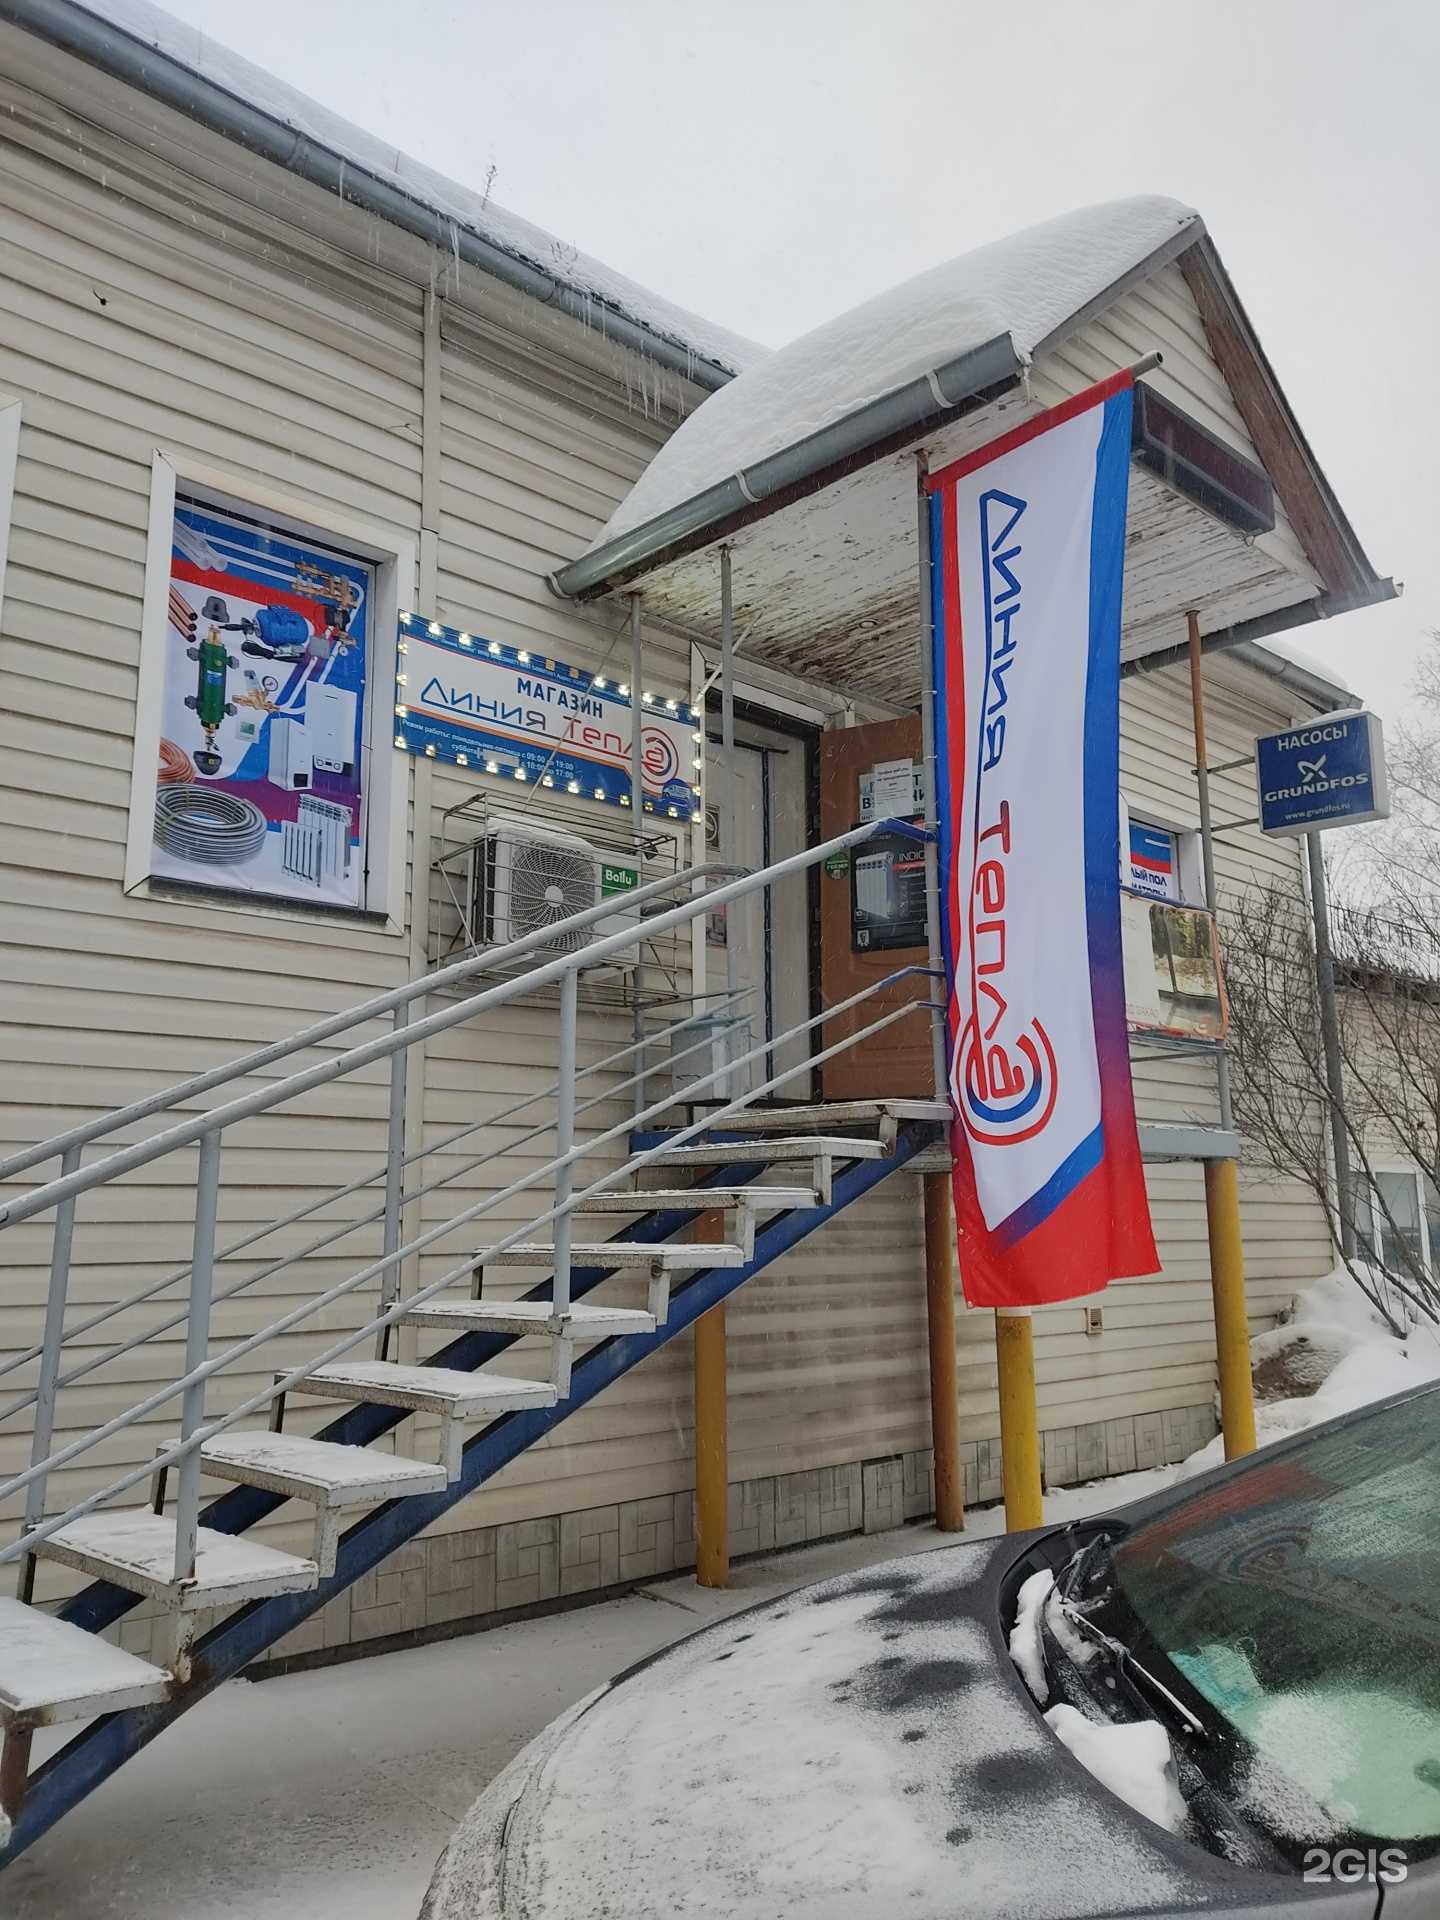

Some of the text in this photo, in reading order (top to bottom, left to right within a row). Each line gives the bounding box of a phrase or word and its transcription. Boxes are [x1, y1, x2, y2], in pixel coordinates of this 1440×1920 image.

[517, 677, 603, 719] МАГАЗИН
[1278, 724, 1348, 752] НАСОСЫ
[1264, 773, 1369, 803] GRUNDFOS
[1284, 803, 1351, 821] www.grundfos.ru
